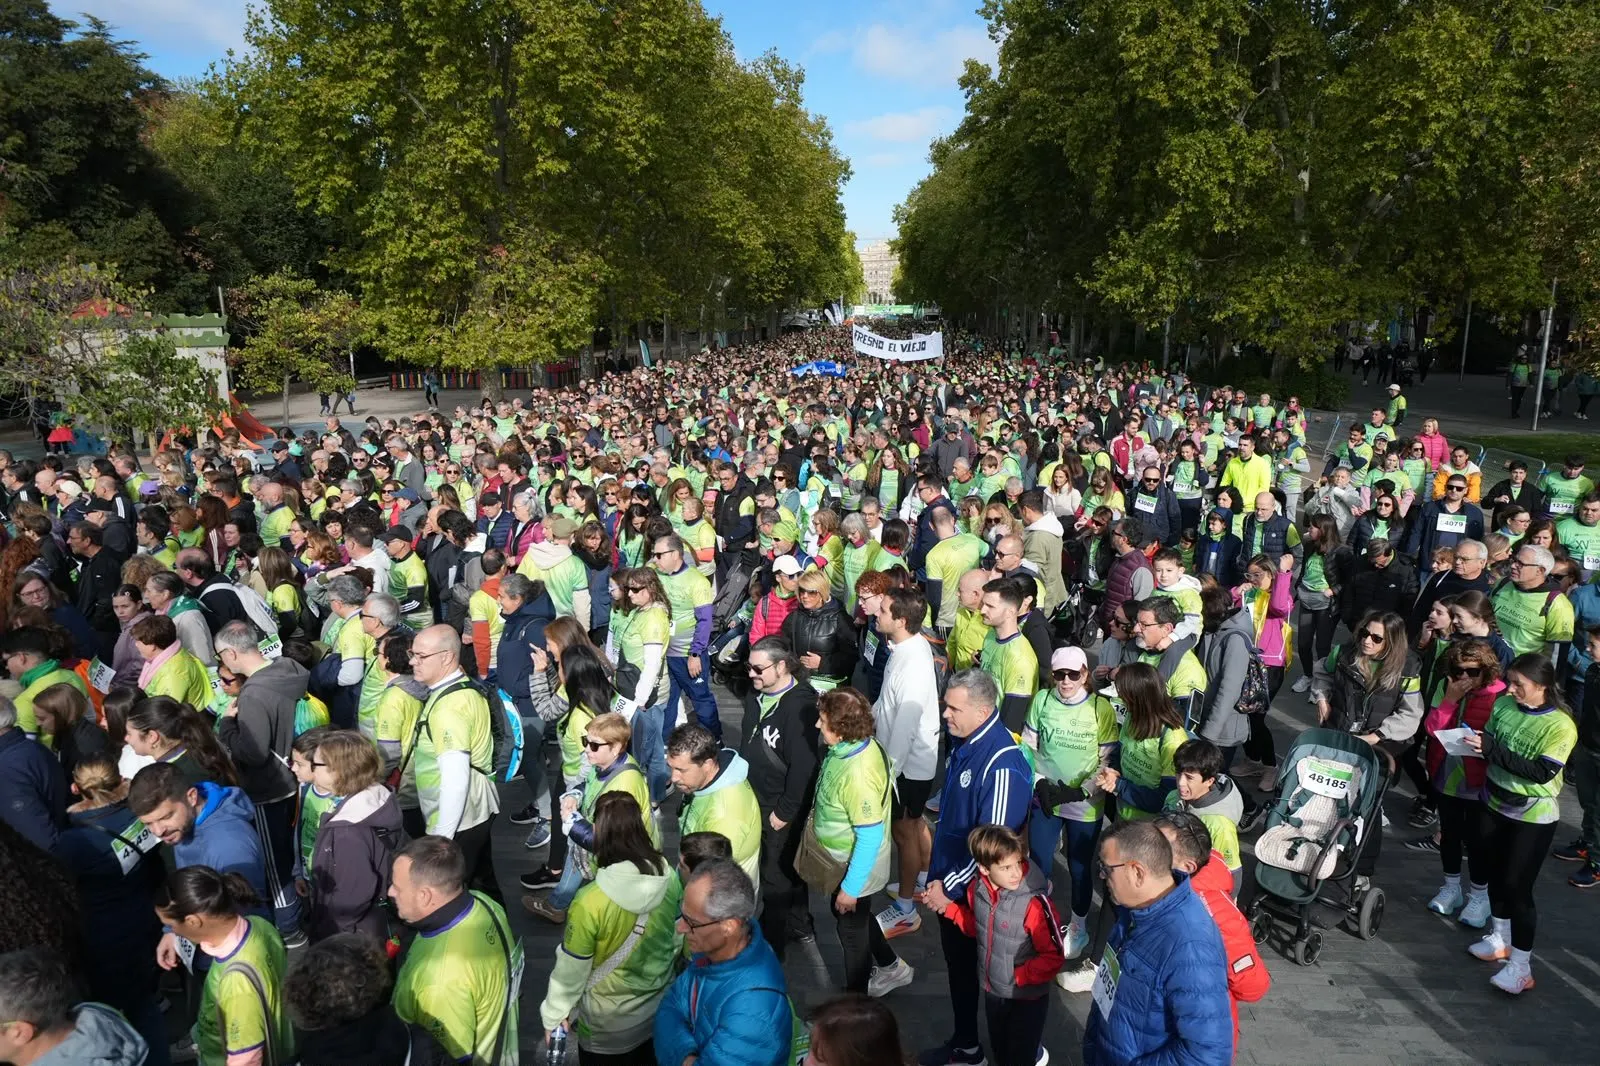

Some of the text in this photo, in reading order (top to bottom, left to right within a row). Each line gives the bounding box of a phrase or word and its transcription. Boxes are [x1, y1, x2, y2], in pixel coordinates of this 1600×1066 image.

[854, 330, 927, 352] FRESNO EL VIEJO
[1575, 540, 1589, 550] XV
[260, 643, 280, 656] 206
[1055, 727, 1065, 736] En
[1055, 740, 1087, 751] Valladolid
[1129, 751, 1153, 770] Marcha
[1308, 772, 1347, 790] 48185
